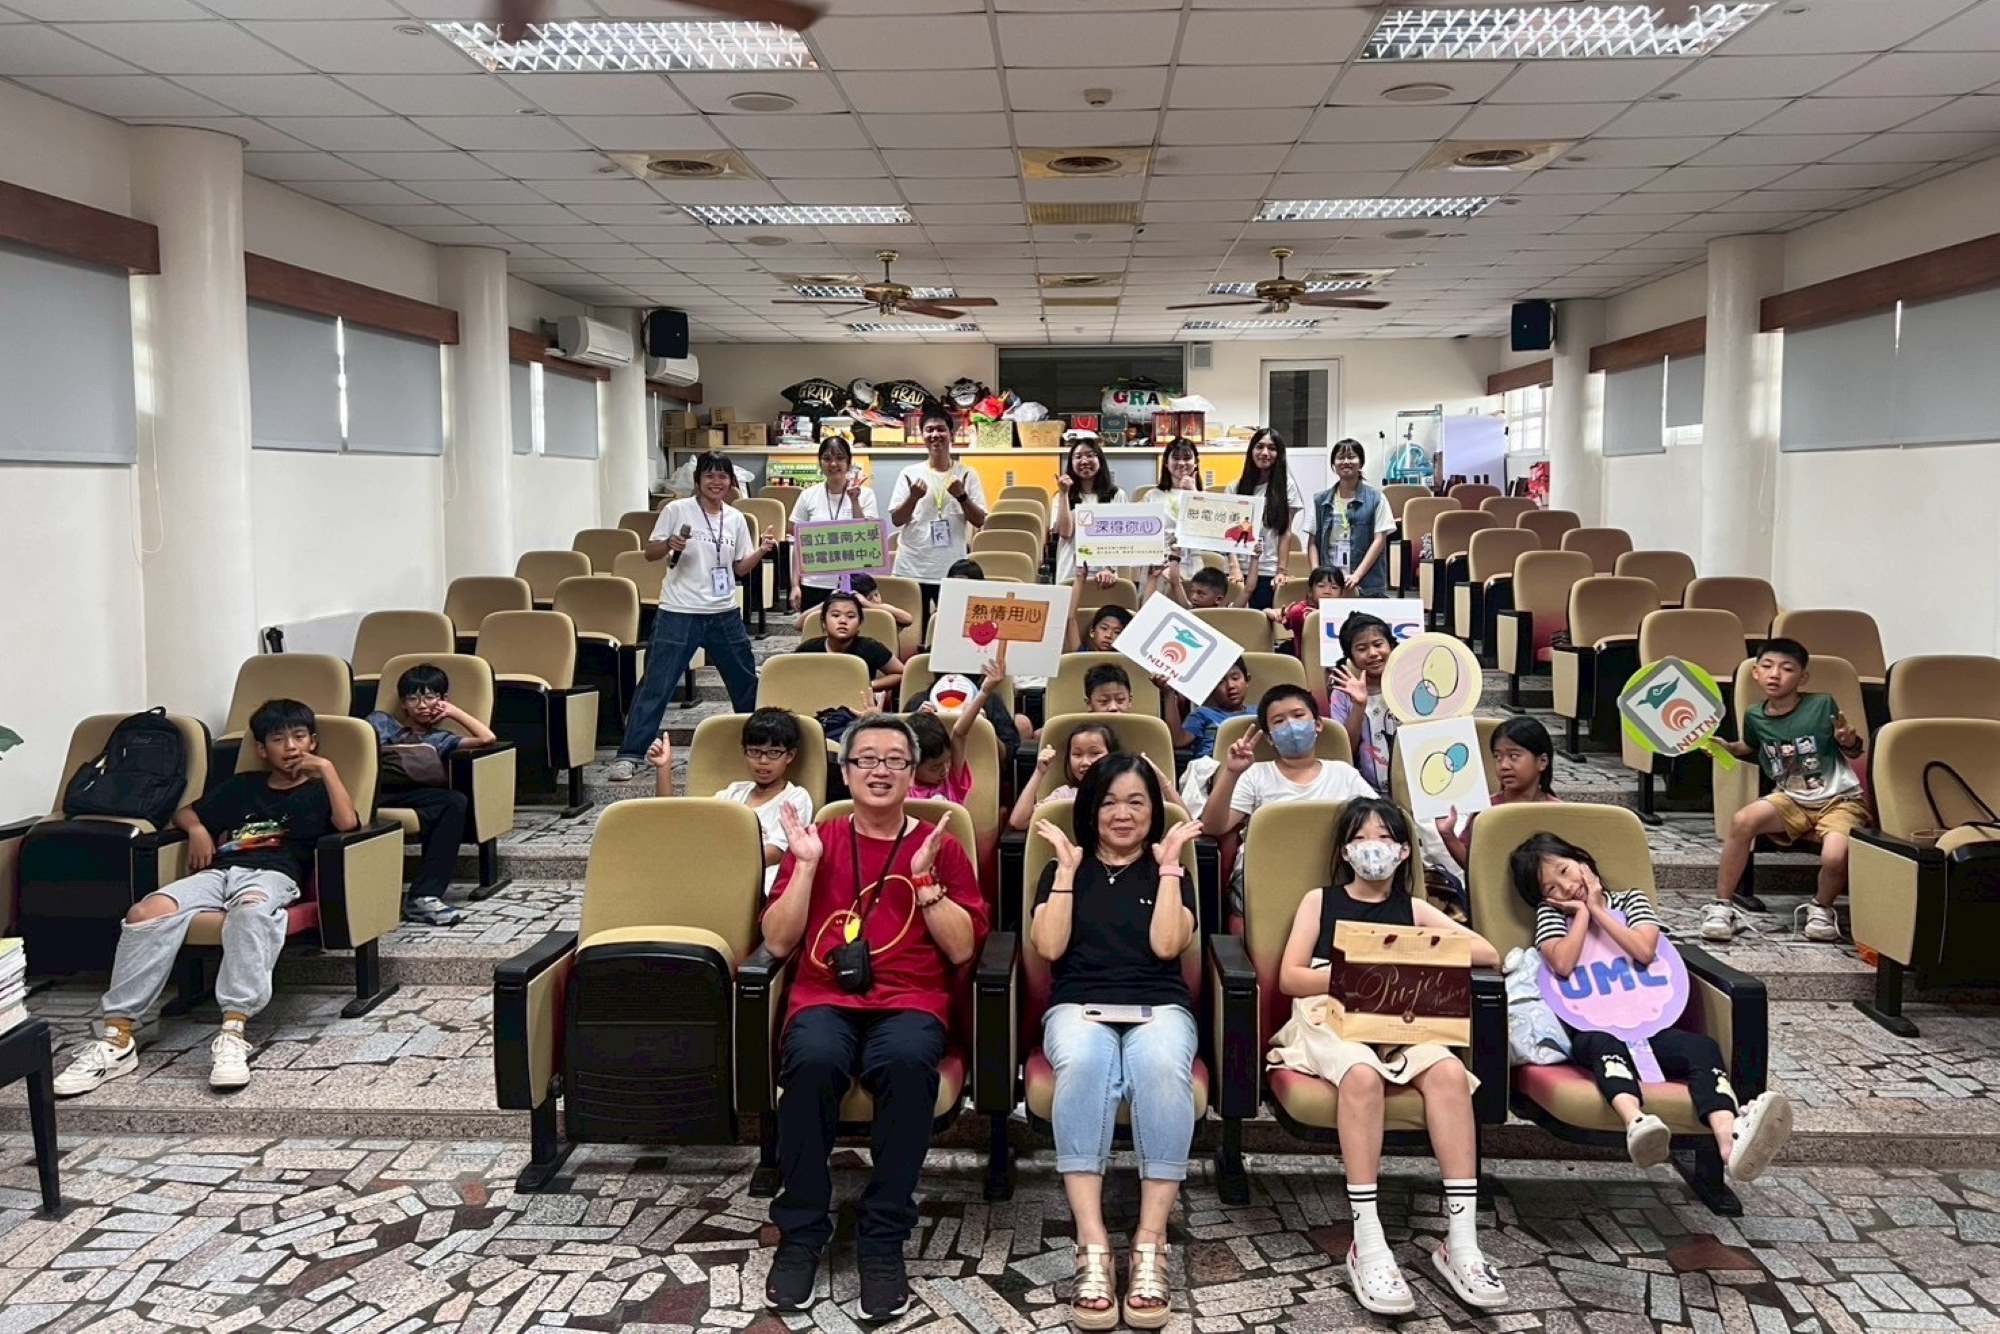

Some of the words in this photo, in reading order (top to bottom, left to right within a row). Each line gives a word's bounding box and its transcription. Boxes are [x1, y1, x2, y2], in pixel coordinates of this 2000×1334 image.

[1095, 520, 1154, 534] 深得你心
[971, 604, 1042, 623] 熱情用心
[1326, 622, 1420, 639] UC
[1147, 654, 1179, 678] NUTN
[1676, 714, 1718, 751] NUTN
